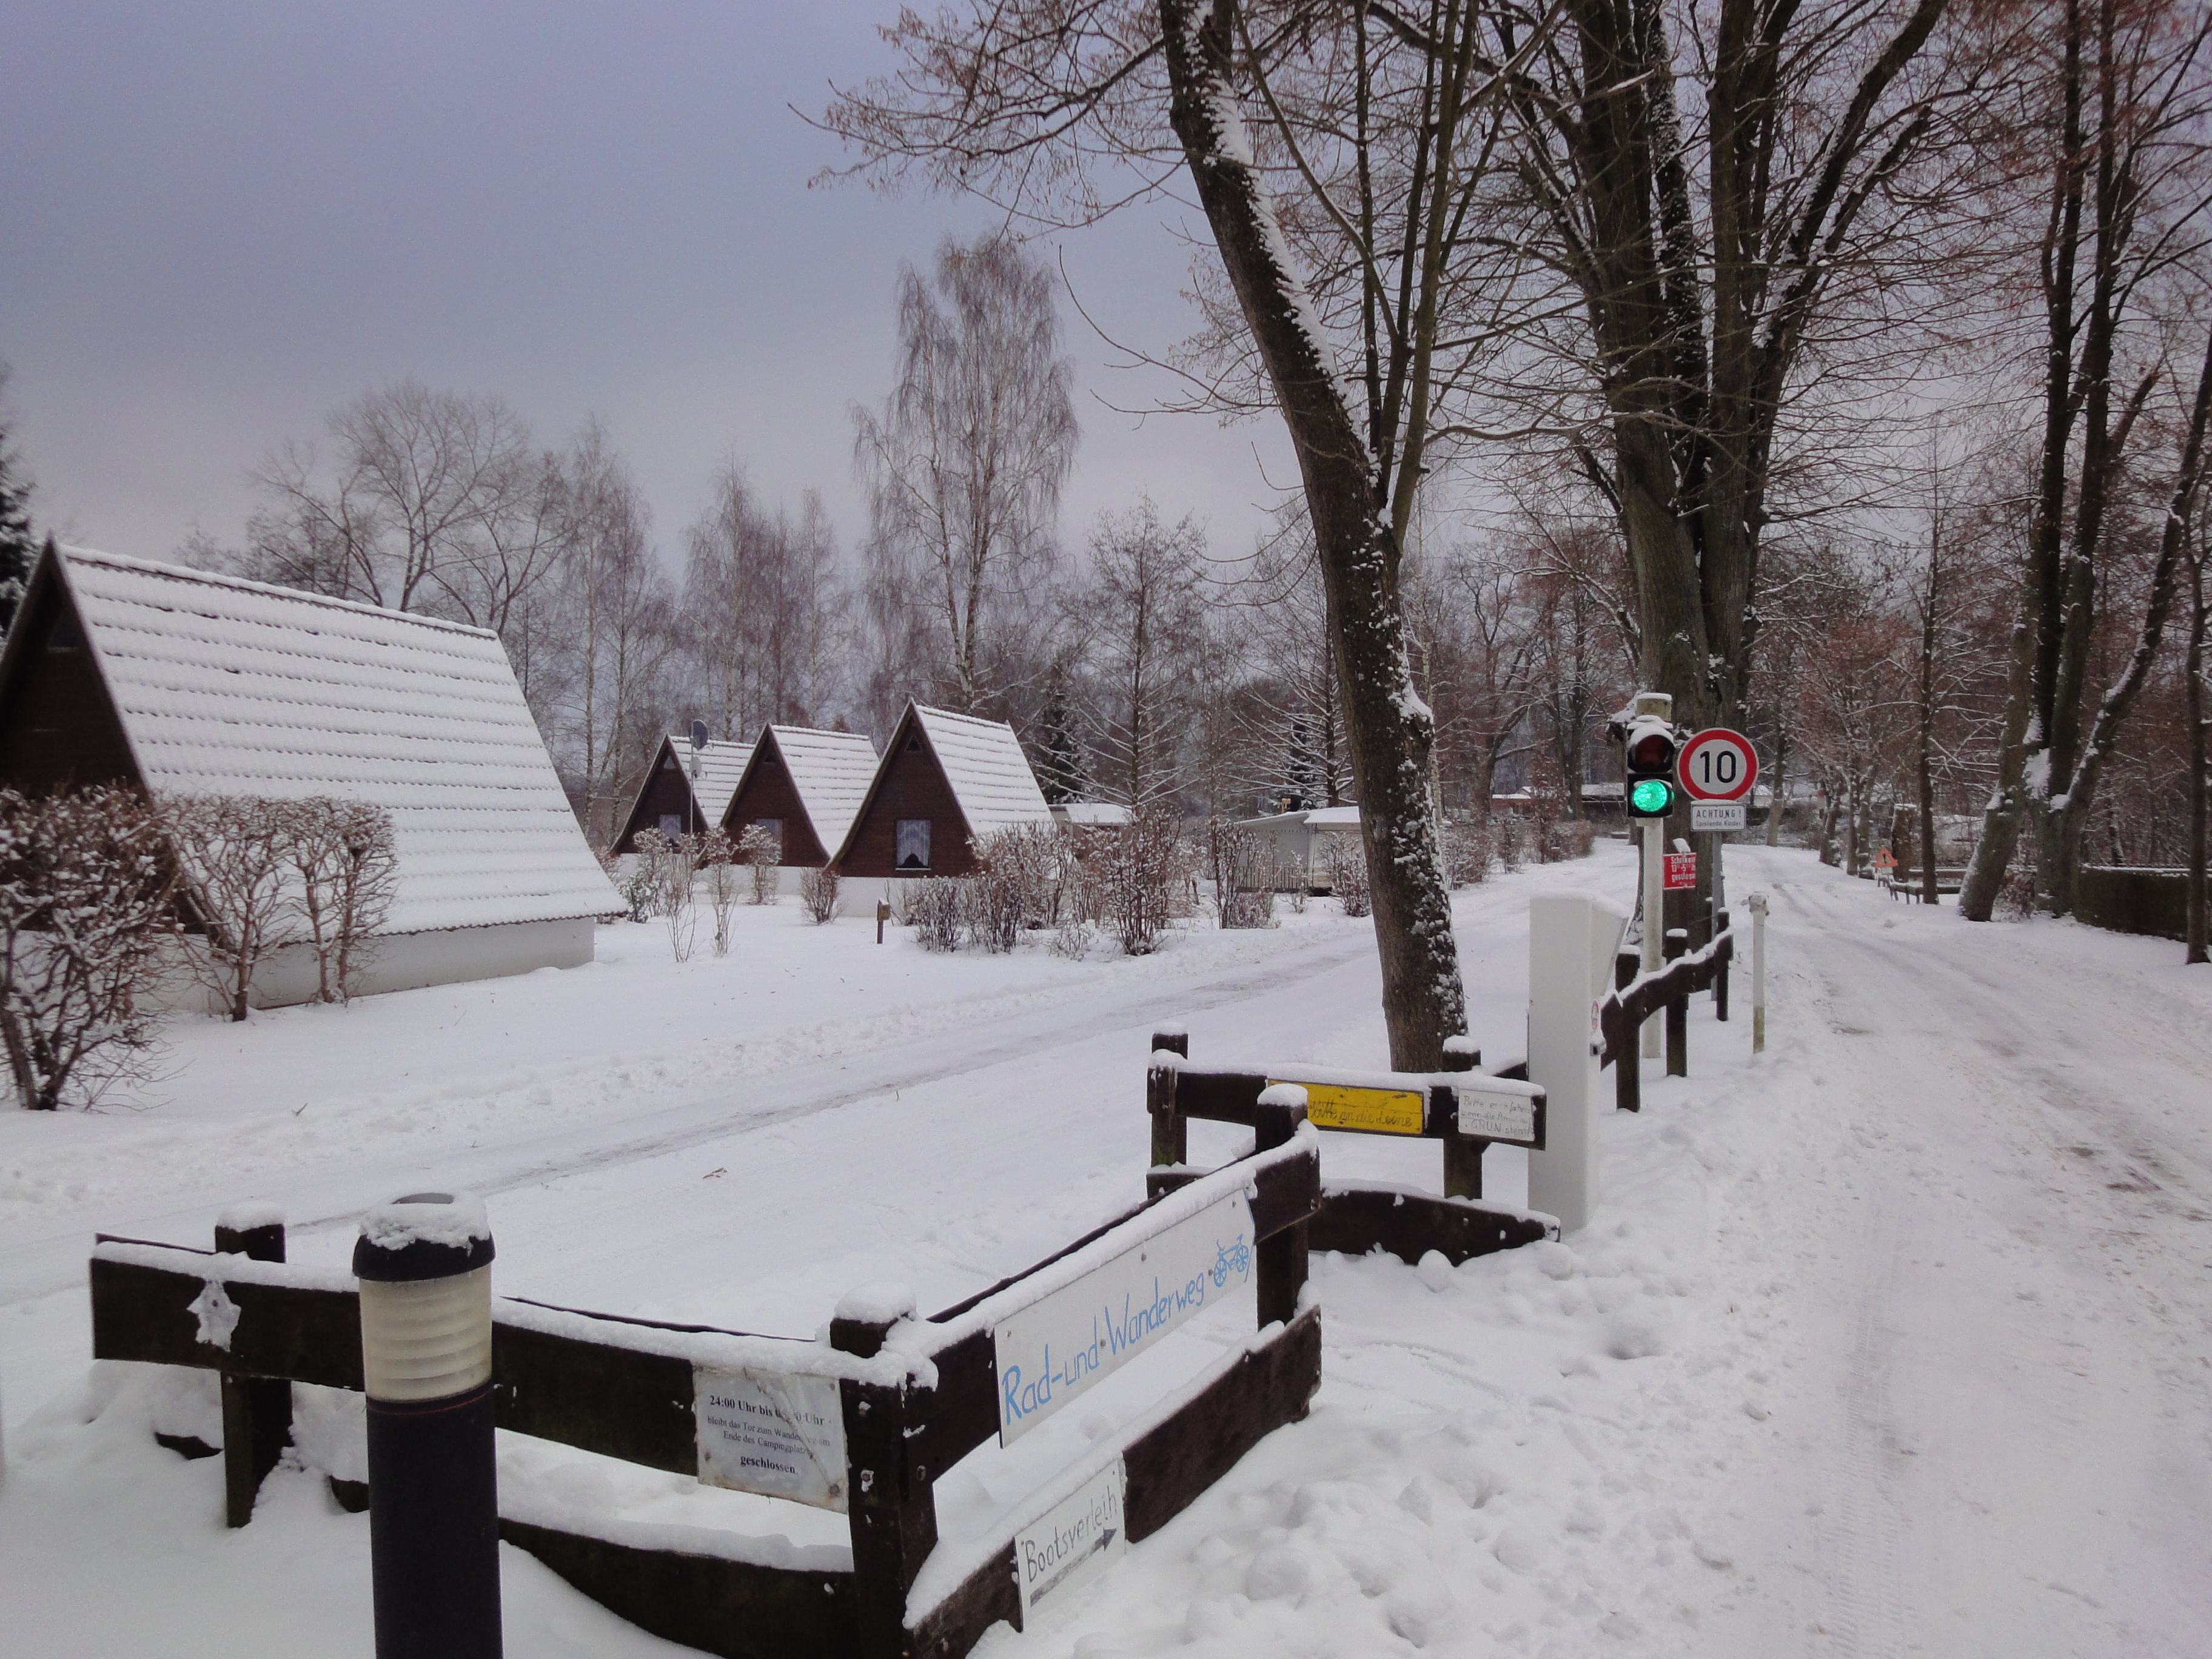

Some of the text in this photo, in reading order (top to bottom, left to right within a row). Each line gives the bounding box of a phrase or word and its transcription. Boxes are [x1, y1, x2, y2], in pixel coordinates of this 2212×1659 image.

[1700, 750, 1737, 784] 10
[1464, 1095, 1484, 1108] Bitte
[1104, 1272, 1205, 1355] Wanderweg
[709, 1395, 736, 1410] 24:00
[738, 1401, 756, 1413] Uhr
[759, 1404, 773, 1417] bis
[805, 1412, 825, 1426] Uhr
[707, 1416, 728, 1428] bleibt
[729, 1418, 741, 1429] das
[742, 1421, 756, 1432] Tor
[757, 1426, 773, 1435] zum
[819, 1438, 831, 1447] am
[723, 1430, 742, 1442] Ende
[743, 1433, 756, 1444] des
[1024, 1484, 1119, 1584] Bootsverleih
